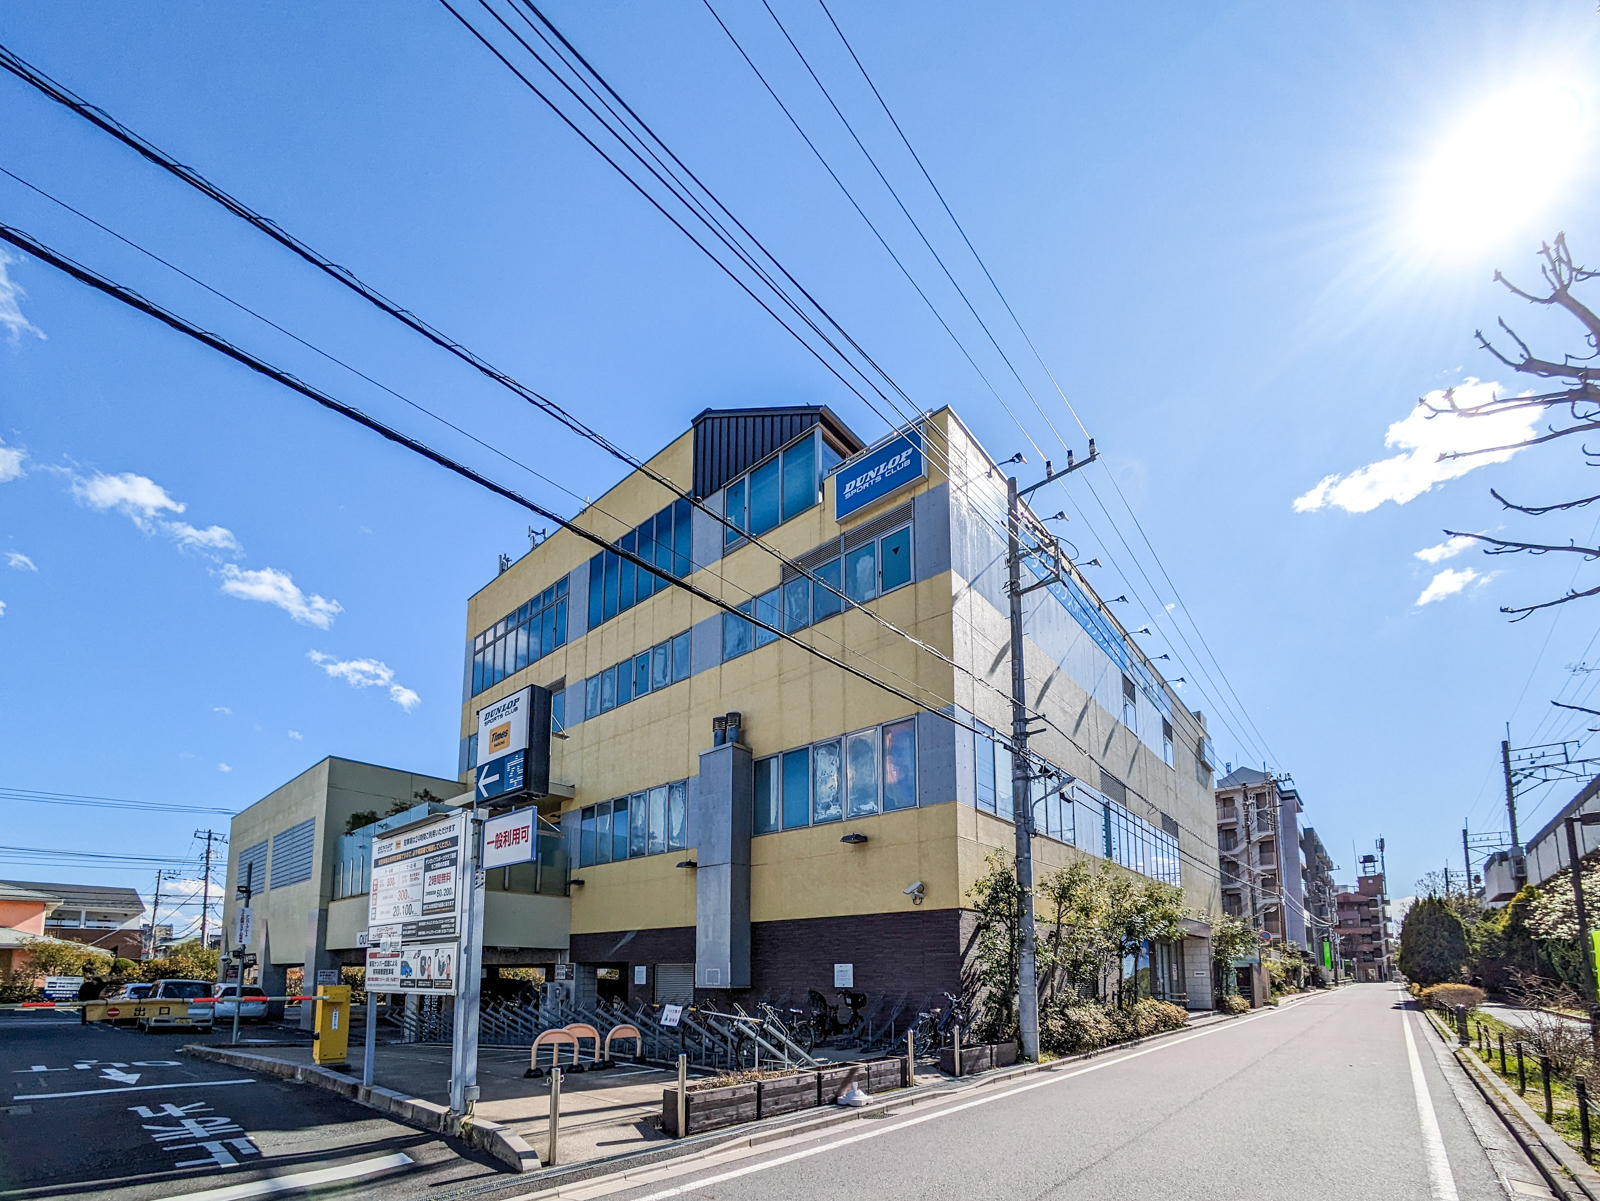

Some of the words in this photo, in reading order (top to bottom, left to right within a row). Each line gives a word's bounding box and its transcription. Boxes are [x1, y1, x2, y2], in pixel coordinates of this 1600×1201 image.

[842, 447, 913, 495] DUNLOP
[844, 474, 882, 500] SPORTS
[884, 459, 911, 478] CLUB
[483, 697, 521, 722] DUNLOP
[484, 712, 504, 727] SPORTS
[504, 706, 519, 717] CLUB
[491, 729, 509, 743] Times
[486, 824, 530, 850] 一般利用可
[428, 871, 452, 887] 2時間無料
[133, 1006, 171, 1017] 出口
[12, 1059, 182, 1073] OUT
[127, 1101, 259, 1168] 止まれ
